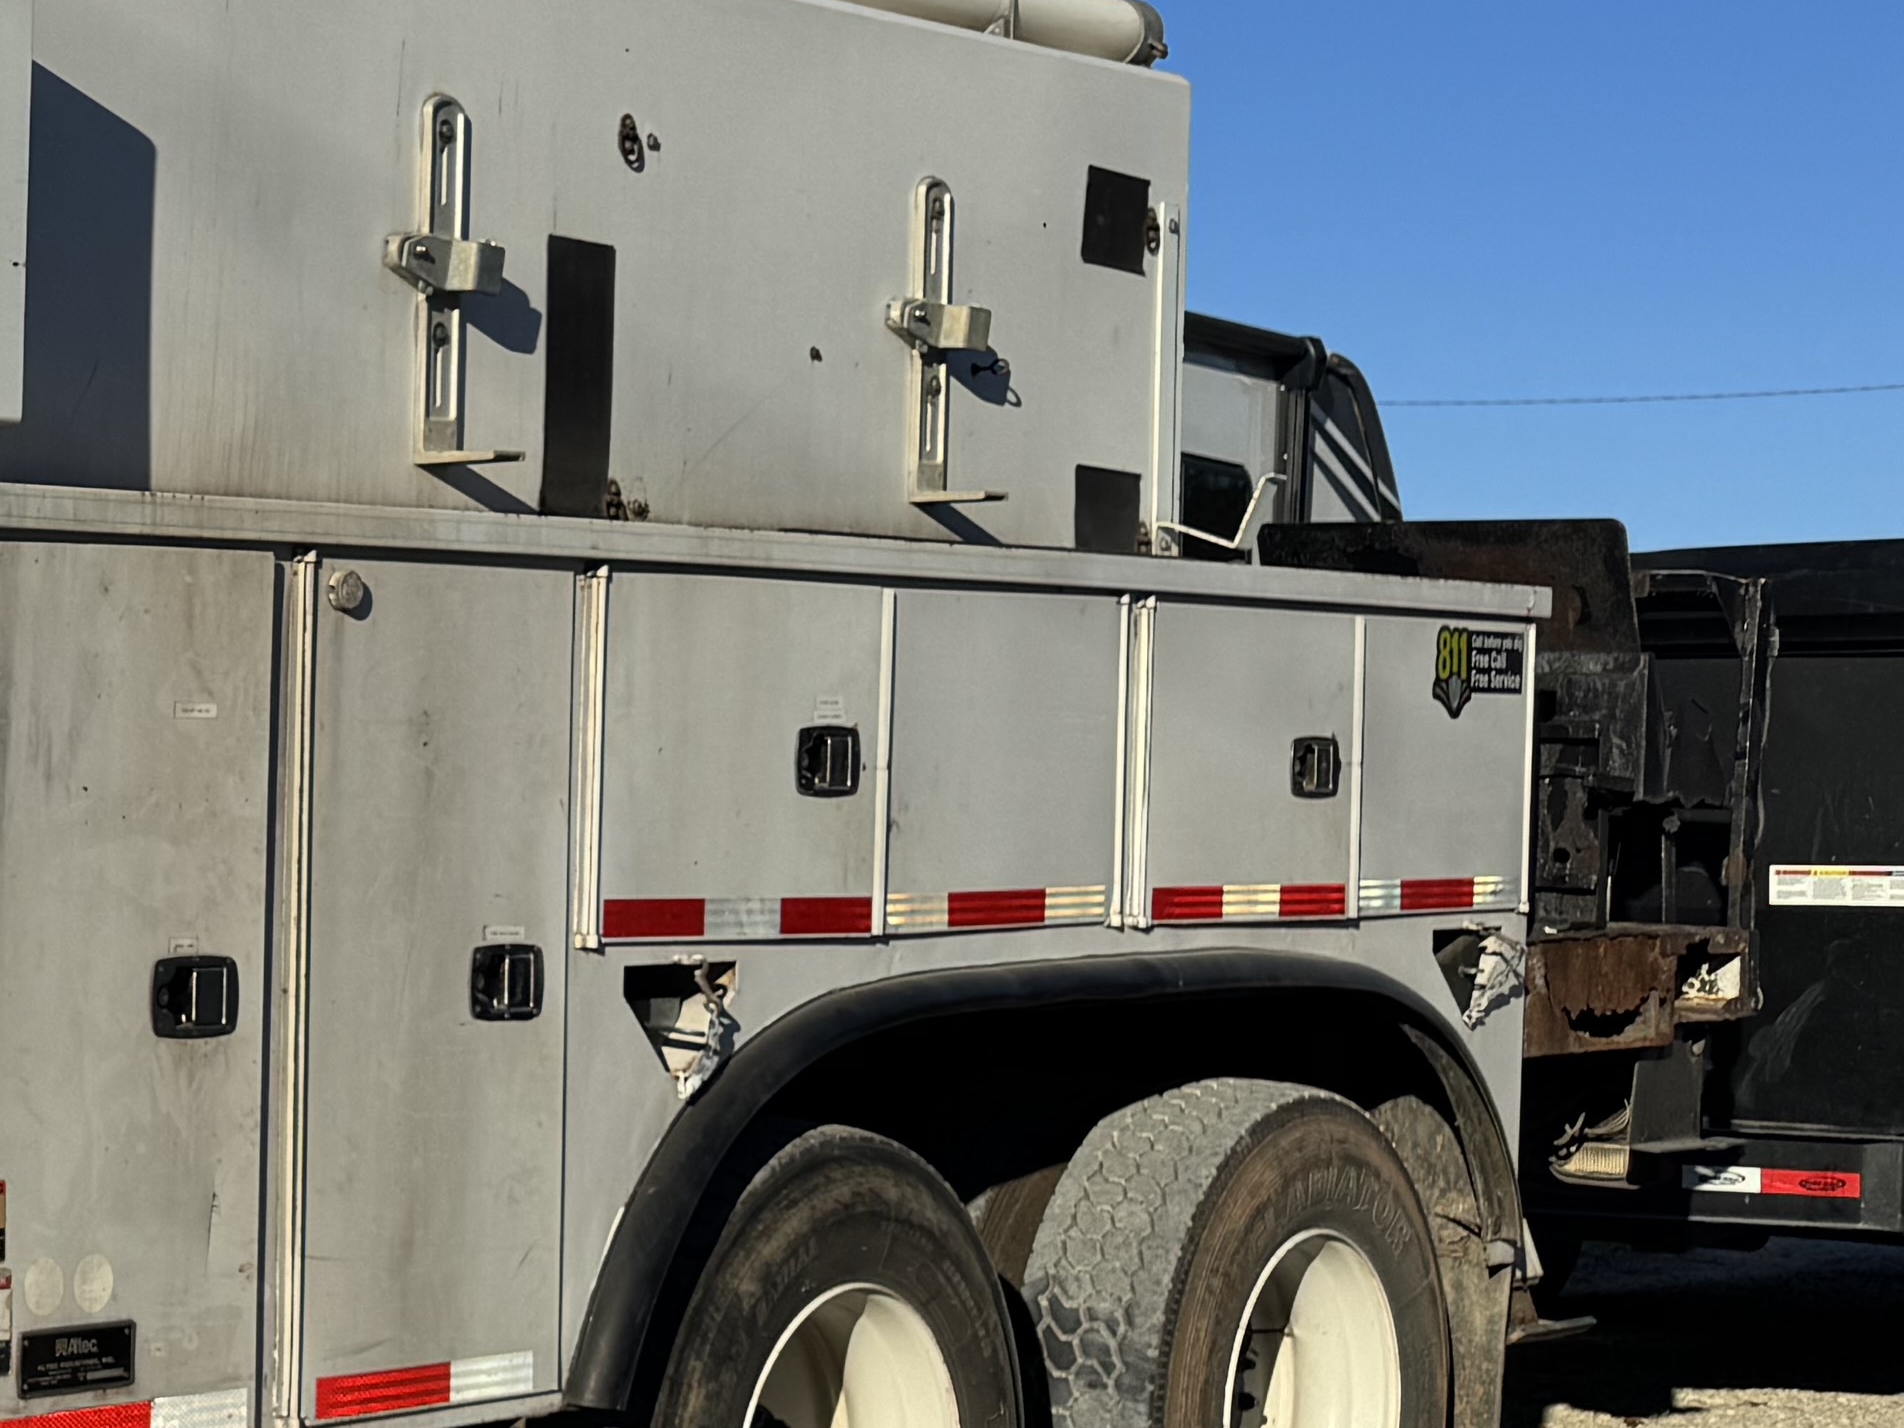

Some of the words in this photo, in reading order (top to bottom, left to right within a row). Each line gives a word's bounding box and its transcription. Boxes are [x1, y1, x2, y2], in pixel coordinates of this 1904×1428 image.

[1472, 634, 1483, 648] Call
[1483, 635, 1502, 649] before
[1502, 637, 1513, 651] you
[1513, 635, 1523, 652] dig
[1438, 629, 1468, 681] 811
[1471, 650, 1490, 668] Free
[1490, 650, 1507, 669] Call
[1471, 669, 1489, 688] Free
[1490, 670, 1521, 689] Service
[67, 1337, 99, 1355] Altec
